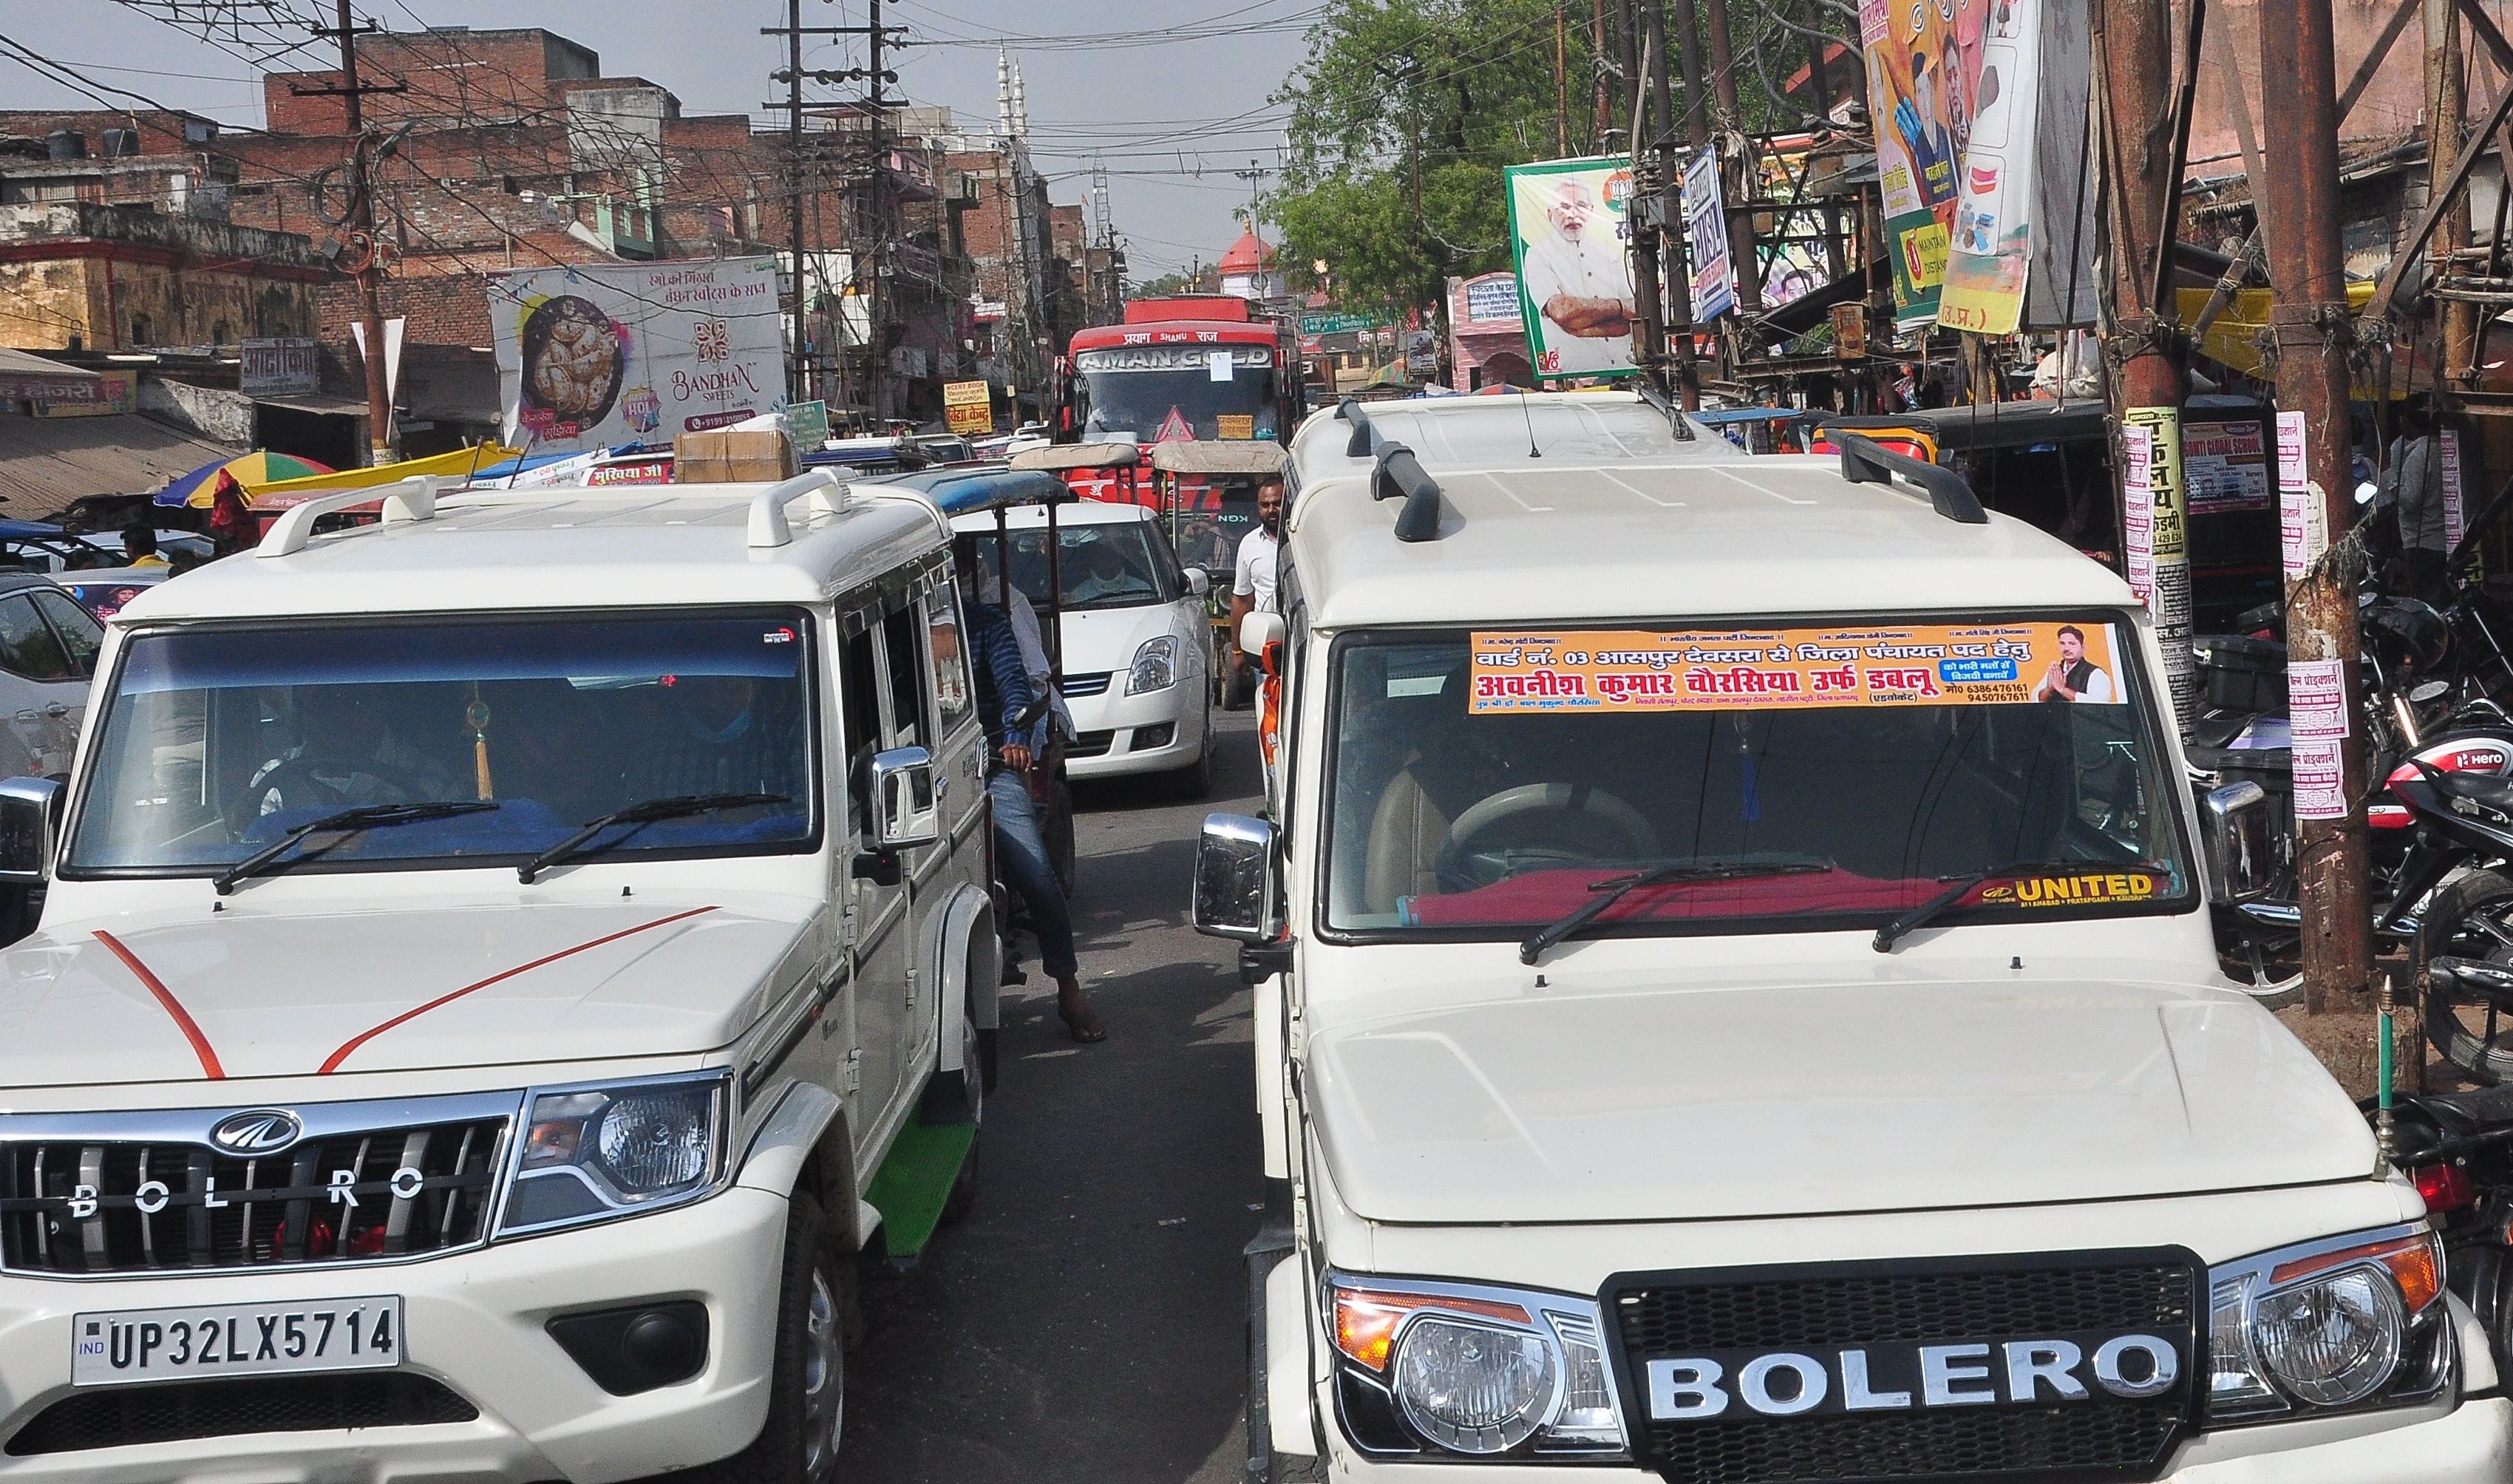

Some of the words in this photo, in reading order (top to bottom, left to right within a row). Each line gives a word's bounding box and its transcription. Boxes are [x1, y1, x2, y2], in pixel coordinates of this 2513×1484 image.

[1918, 235, 1947, 251] MAINTAIN
[1925, 259, 1947, 274] DISTANC
[1123, 333, 1151, 345] प्रयाग
[1196, 332, 1218, 343] राज
[1160, 333, 1187, 342] SHANU
[1081, 350, 1173, 370] AMAN
[672, 363, 760, 402] BANDHAN
[703, 389, 735, 403] SWEETS
[948, 406, 967, 423] विद्या
[968, 405, 989, 423] केन्द्र
[2207, 438, 2233, 456] GLOBAL
[2233, 438, 2261, 455] SCHOOL
[594, 465, 641, 486] मुखिया
[645, 464, 663, 480] जी
[1218, 514, 1248, 523] KGN
[2158, 534, 2171, 543] 429
[1476, 647, 1521, 666] वार्ड
[1525, 647, 1557, 665] नं.
[1564, 652, 1589, 665] 03
[1595, 650, 1681, 670] आसपुर
[1683, 645, 1764, 664] देवसरा
[1766, 644, 1792, 662] से
[1795, 642, 1860, 662] जिला
[1863, 641, 1947, 660] पंचायत
[1950, 642, 1987, 657] पद
[1991, 638, 2032, 662] हेतु
[1943, 662, 1957, 671] को
[1959, 661, 1978, 670] भारी
[1477, 670, 1585, 697] अवनीश
[1596, 674, 1675, 702] कुमार
[1684, 667, 1800, 693] चौरसिया
[1810, 664, 1857, 691] उर्फ
[1866, 668, 1940, 697] डबलू
[1968, 683, 2028, 693] 6386476161
[1968, 692, 2030, 702] 9450767611
[2472, 754, 2503, 765] Hero
[2016, 874, 2152, 902] UNITED
[68, 1166, 424, 1219] BOLRO
[109, 1308, 392, 1370] UP32LX5714
[79, 1341, 104, 1355] IND
[1645, 1332, 2184, 1421] BOLERO
